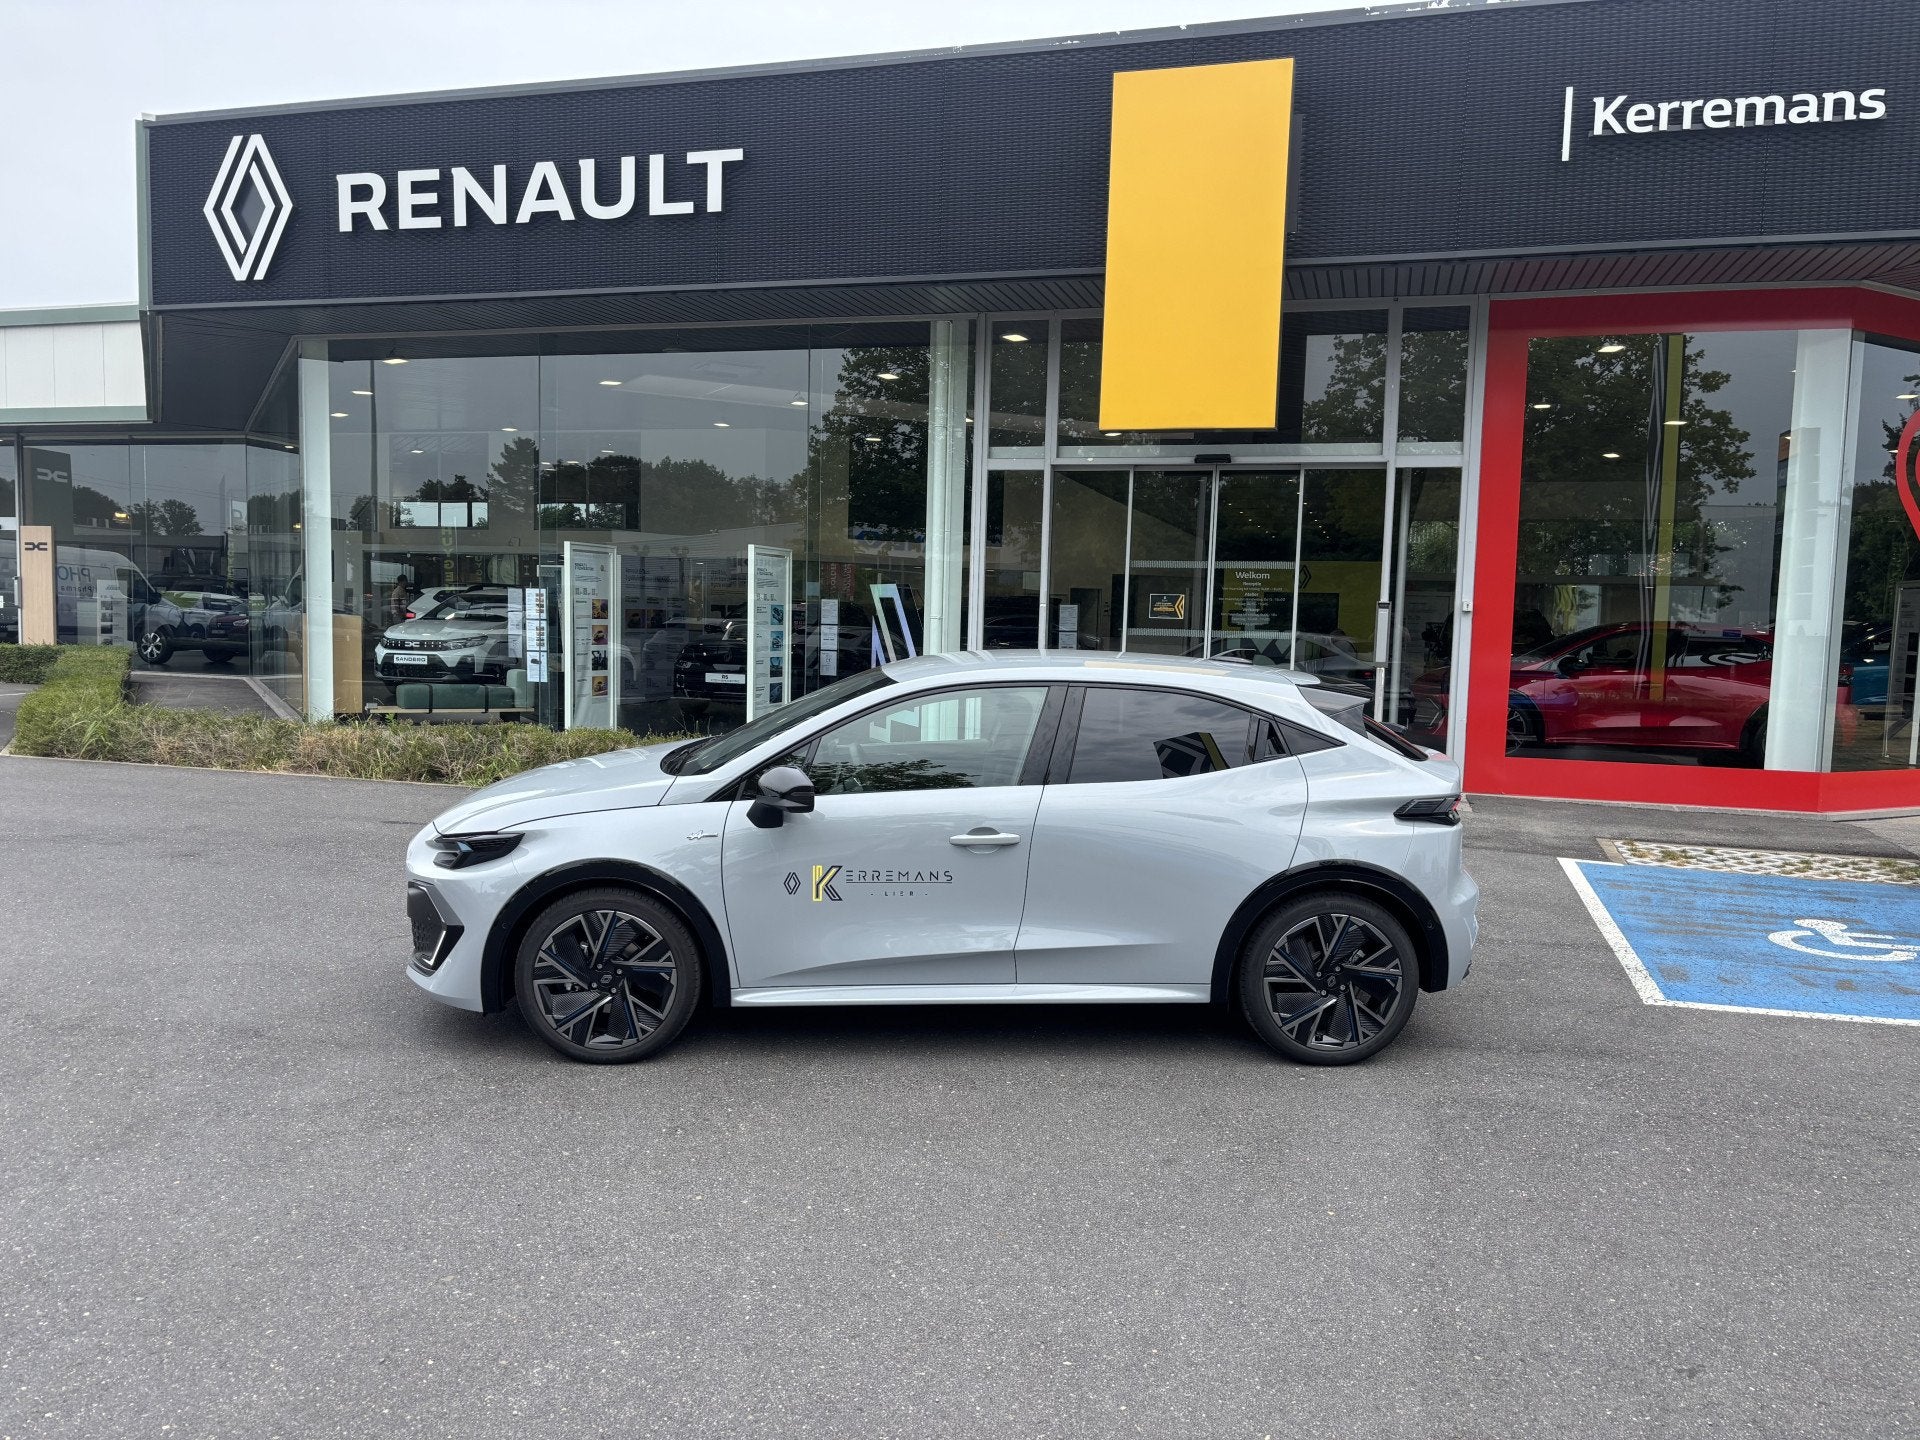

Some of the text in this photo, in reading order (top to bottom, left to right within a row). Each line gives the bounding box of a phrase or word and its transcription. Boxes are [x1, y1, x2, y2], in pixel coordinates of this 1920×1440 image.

[1592, 88, 1888, 136] Kerremans
[336, 148, 744, 233] RENAULT
[1235, 571, 1270, 579] Welkom
